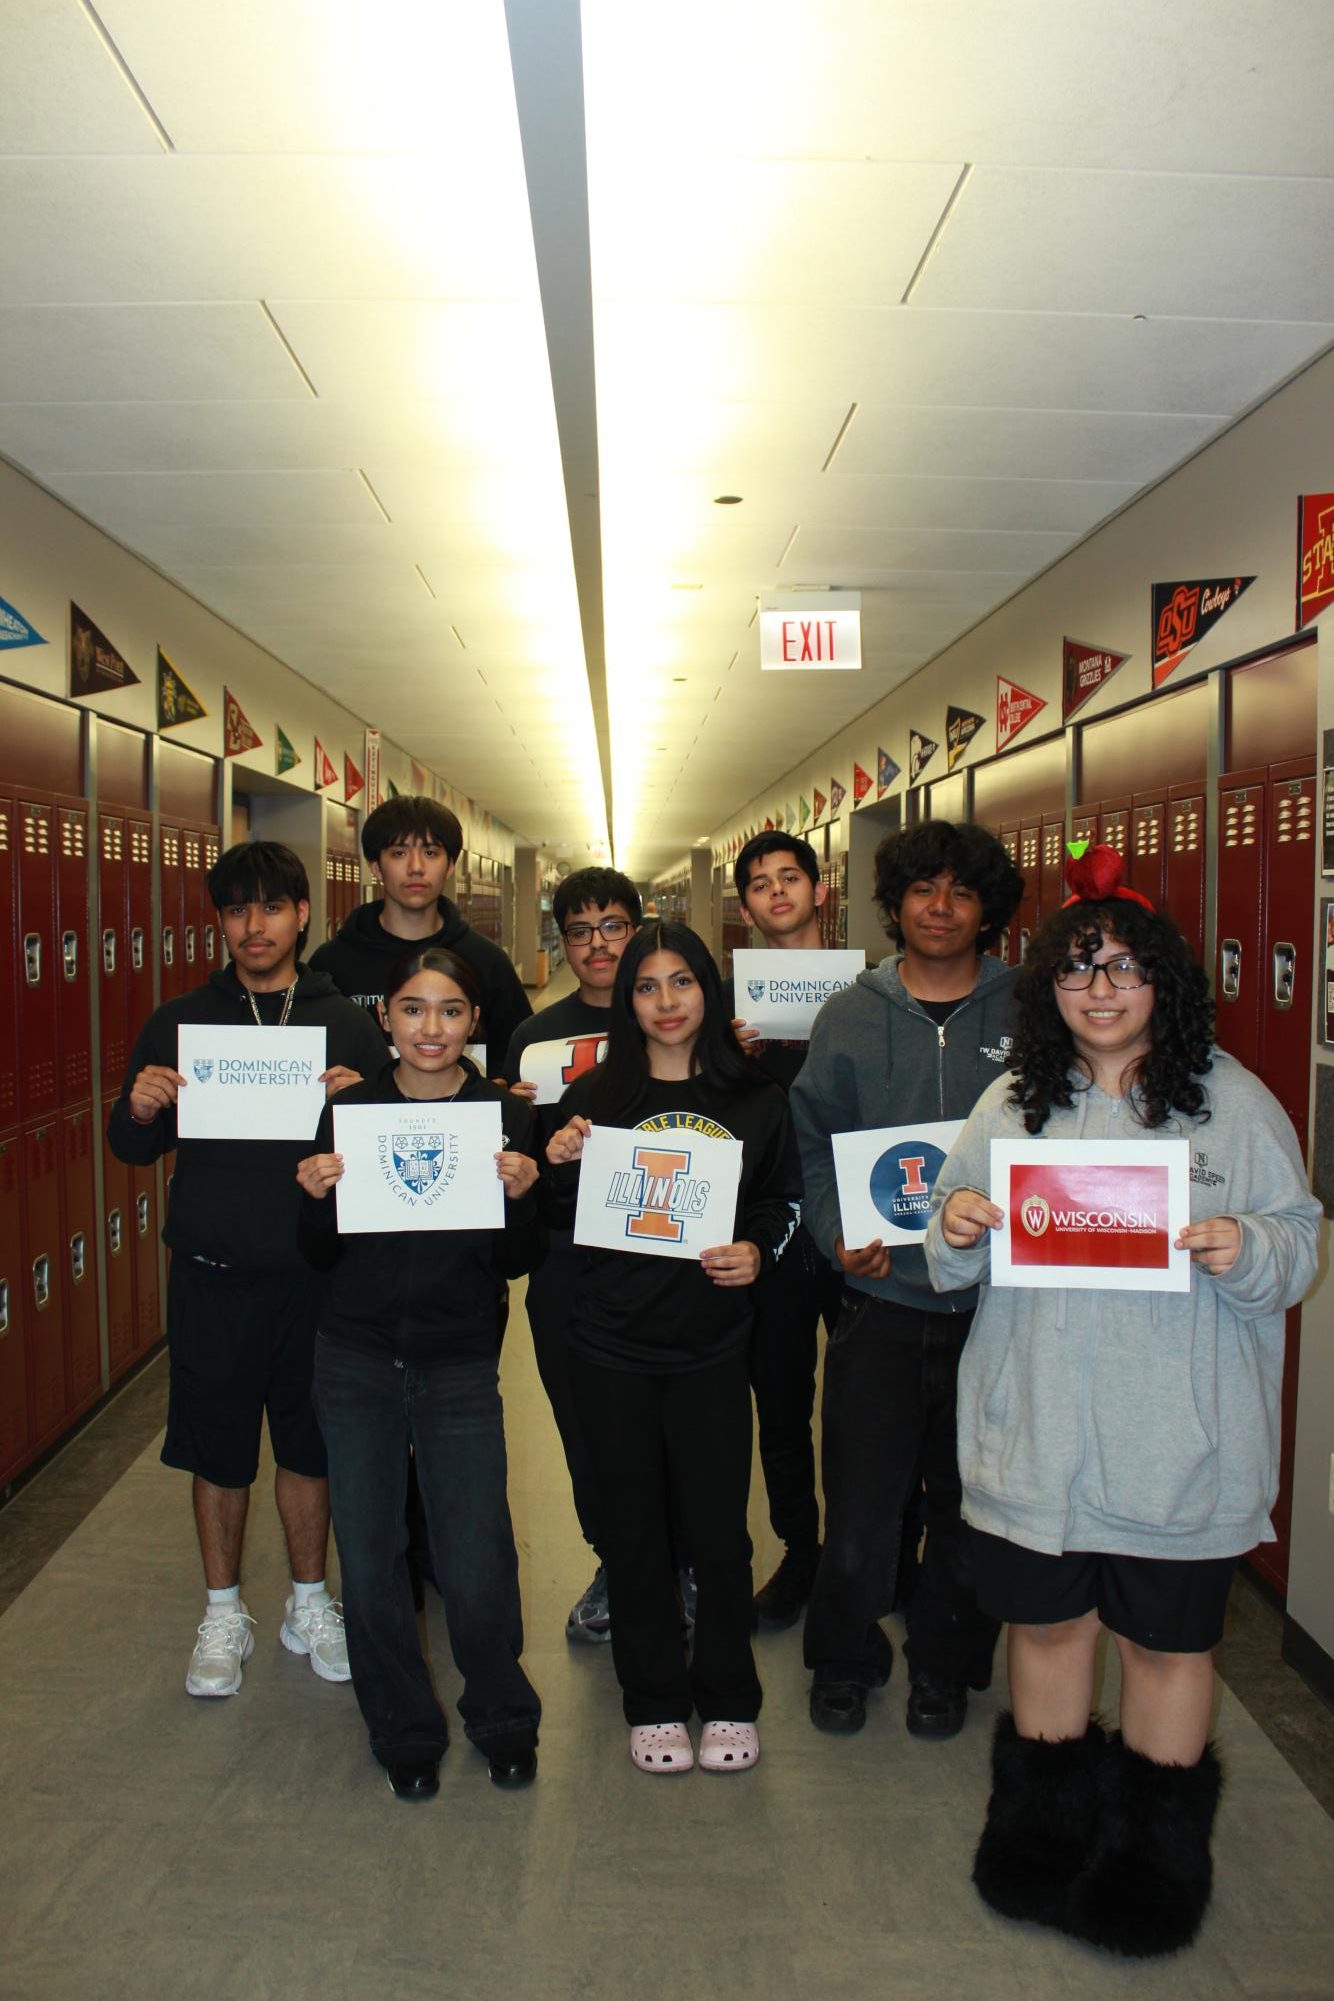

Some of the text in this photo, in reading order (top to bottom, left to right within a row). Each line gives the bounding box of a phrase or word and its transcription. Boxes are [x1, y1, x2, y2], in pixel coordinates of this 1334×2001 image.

[1201, 587, 1231, 615] Cowboys
[1156, 585, 1200, 657] OSU
[782, 621, 837, 661] EXIT
[1079, 654, 1103, 674] MONTANA
[1080, 668, 1102, 687] GRIZZLIES
[769, 981, 853, 991] DOMINICAN
[219, 1059, 312, 1072] DOMINICAN
[219, 1073, 312, 1085] UNIVERSITY
[377, 1133, 459, 1207] DOMINICAN UNIVERSITY
[606, 1171, 711, 1212] ILLINOIS
[1052, 1210, 1157, 1228] WISCONSIN
